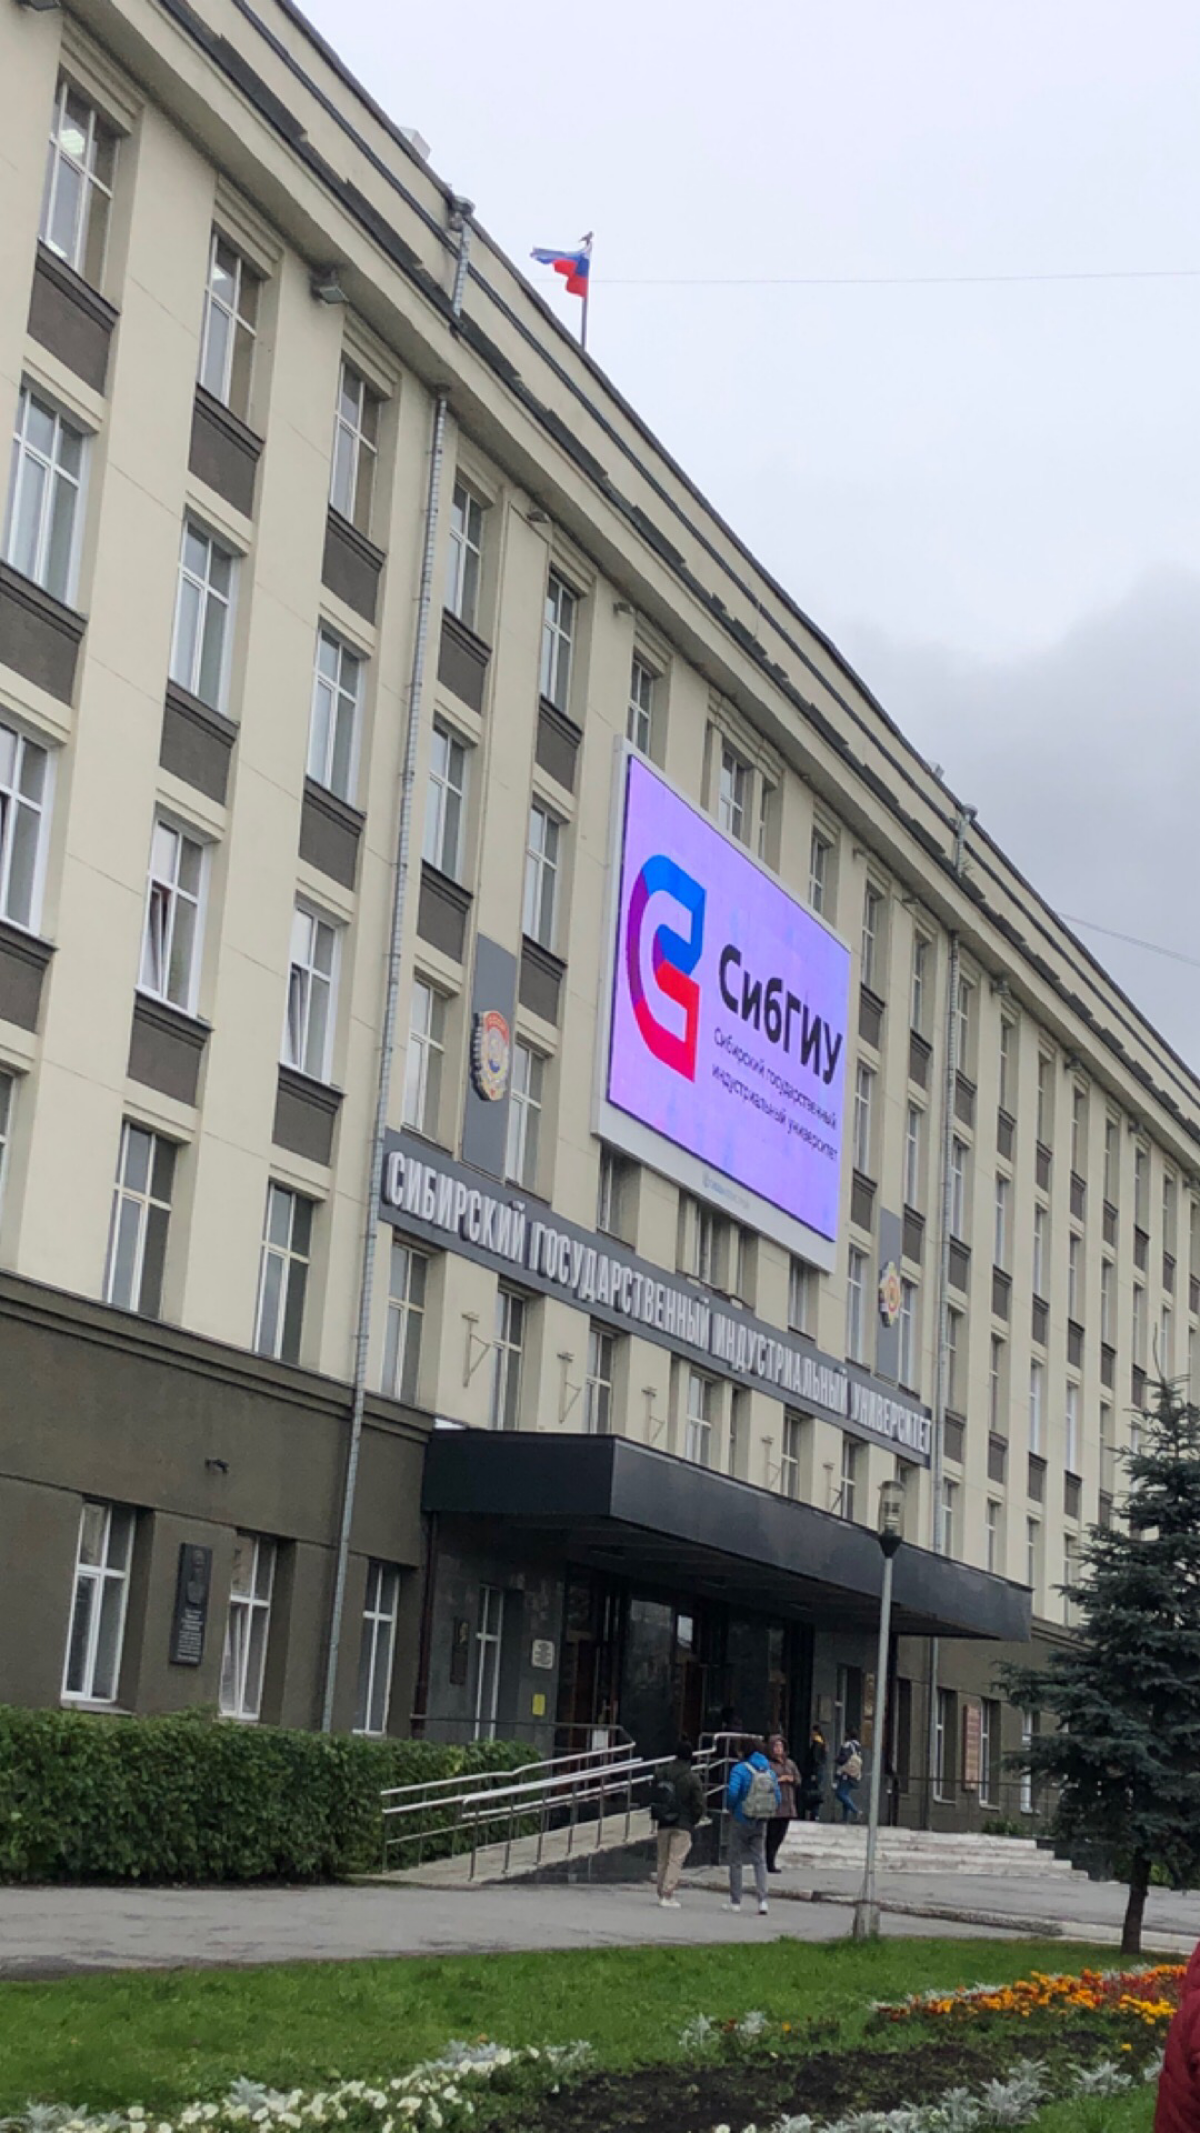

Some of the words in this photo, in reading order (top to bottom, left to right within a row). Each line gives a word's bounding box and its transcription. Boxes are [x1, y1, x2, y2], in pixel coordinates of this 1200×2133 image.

[719, 944, 842, 1085] СибГИУ
[712, 1063, 786, 1124] индустриальный
[714, 1027, 765, 1079] Сибирский
[766, 1068, 836, 1130] государственный
[386, 1152, 525, 1263] СИБИРСКИЙ
[529, 1221, 710, 1350] ГОСУДАРСТВЕННЫЙ
[711, 1313, 848, 1415] ИНДУСТРИАЛЬНЫЙ
[850, 1382, 931, 1454] УНИВЕРСИТЕТ
